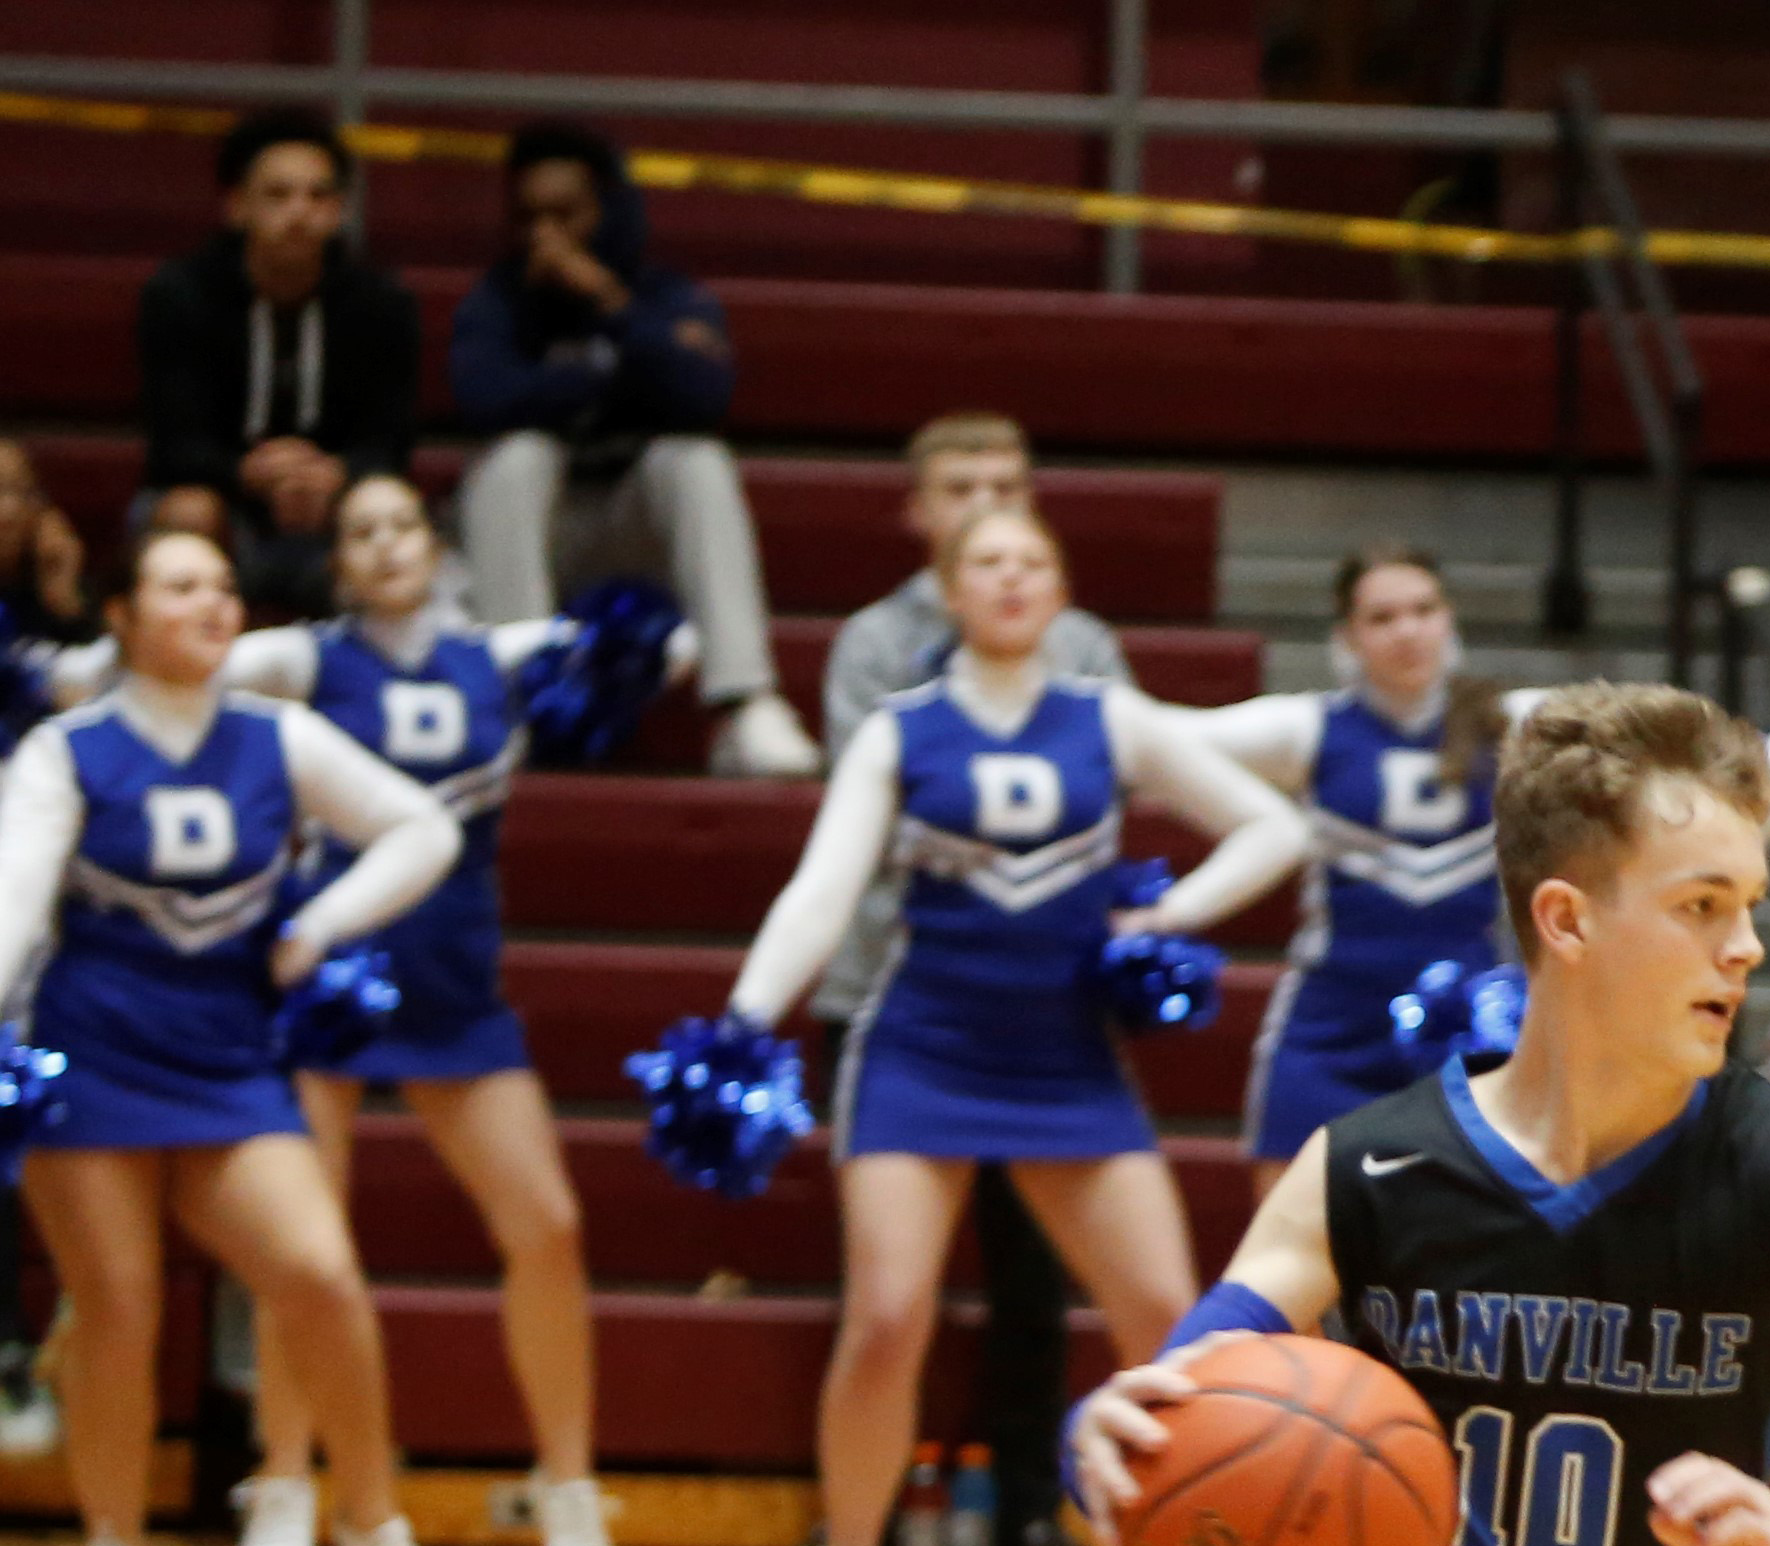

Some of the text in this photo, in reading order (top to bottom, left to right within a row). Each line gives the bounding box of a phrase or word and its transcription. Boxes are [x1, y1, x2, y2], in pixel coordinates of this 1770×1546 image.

[382, 681, 466, 761] D
[147, 786, 237, 876] D
[968, 753, 1063, 838] D
